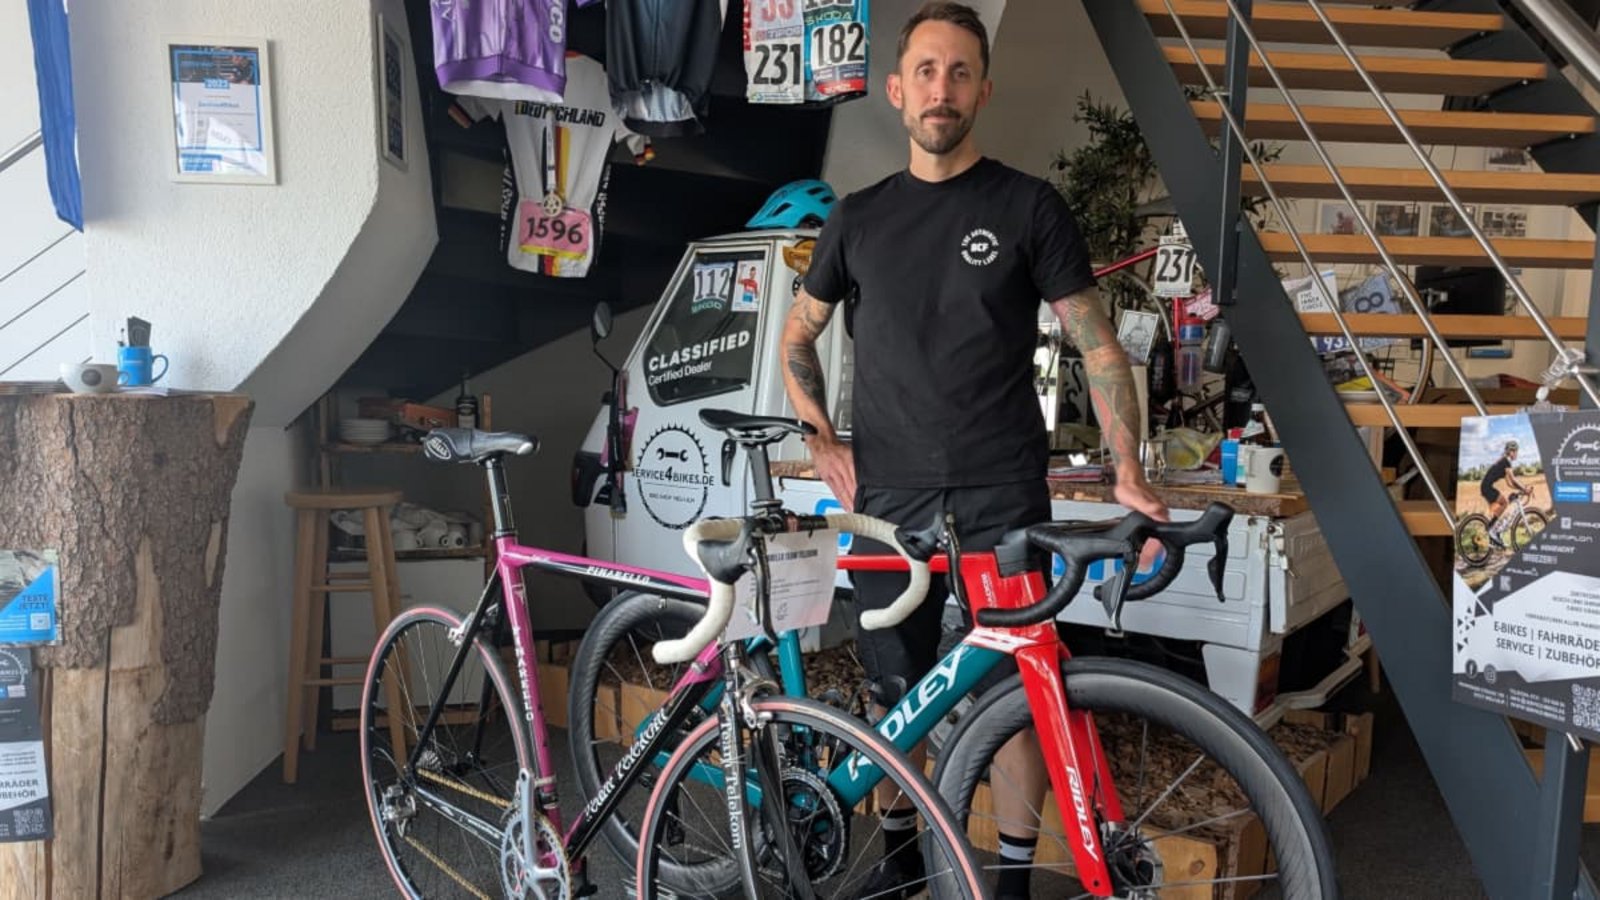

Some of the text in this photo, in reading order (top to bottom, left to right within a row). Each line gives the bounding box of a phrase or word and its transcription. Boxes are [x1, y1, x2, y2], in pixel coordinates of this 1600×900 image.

[814, 22, 865, 67] 182
[754, 43, 800, 85] 231
[520, 101, 606, 128] DEUTCHLAND
[527, 217, 583, 244] 1596
[1157, 249, 1194, 282] 231
[694, 268, 731, 301] 112
[649, 330, 750, 371] CLASSIFIED
[649, 360, 712, 386] Certified Dealer
[632, 466, 715, 486] SERVICE4BIKES.DE
[586, 566, 650, 584] PINARELLO
[1494, 621, 1527, 637] E-BIKES
[1496, 637, 1534, 655] SERVICE
[847, 645, 967, 782] RDLEY
[719, 714, 743, 849] Team Telekom
[1065, 765, 1100, 863] RIDLEY
